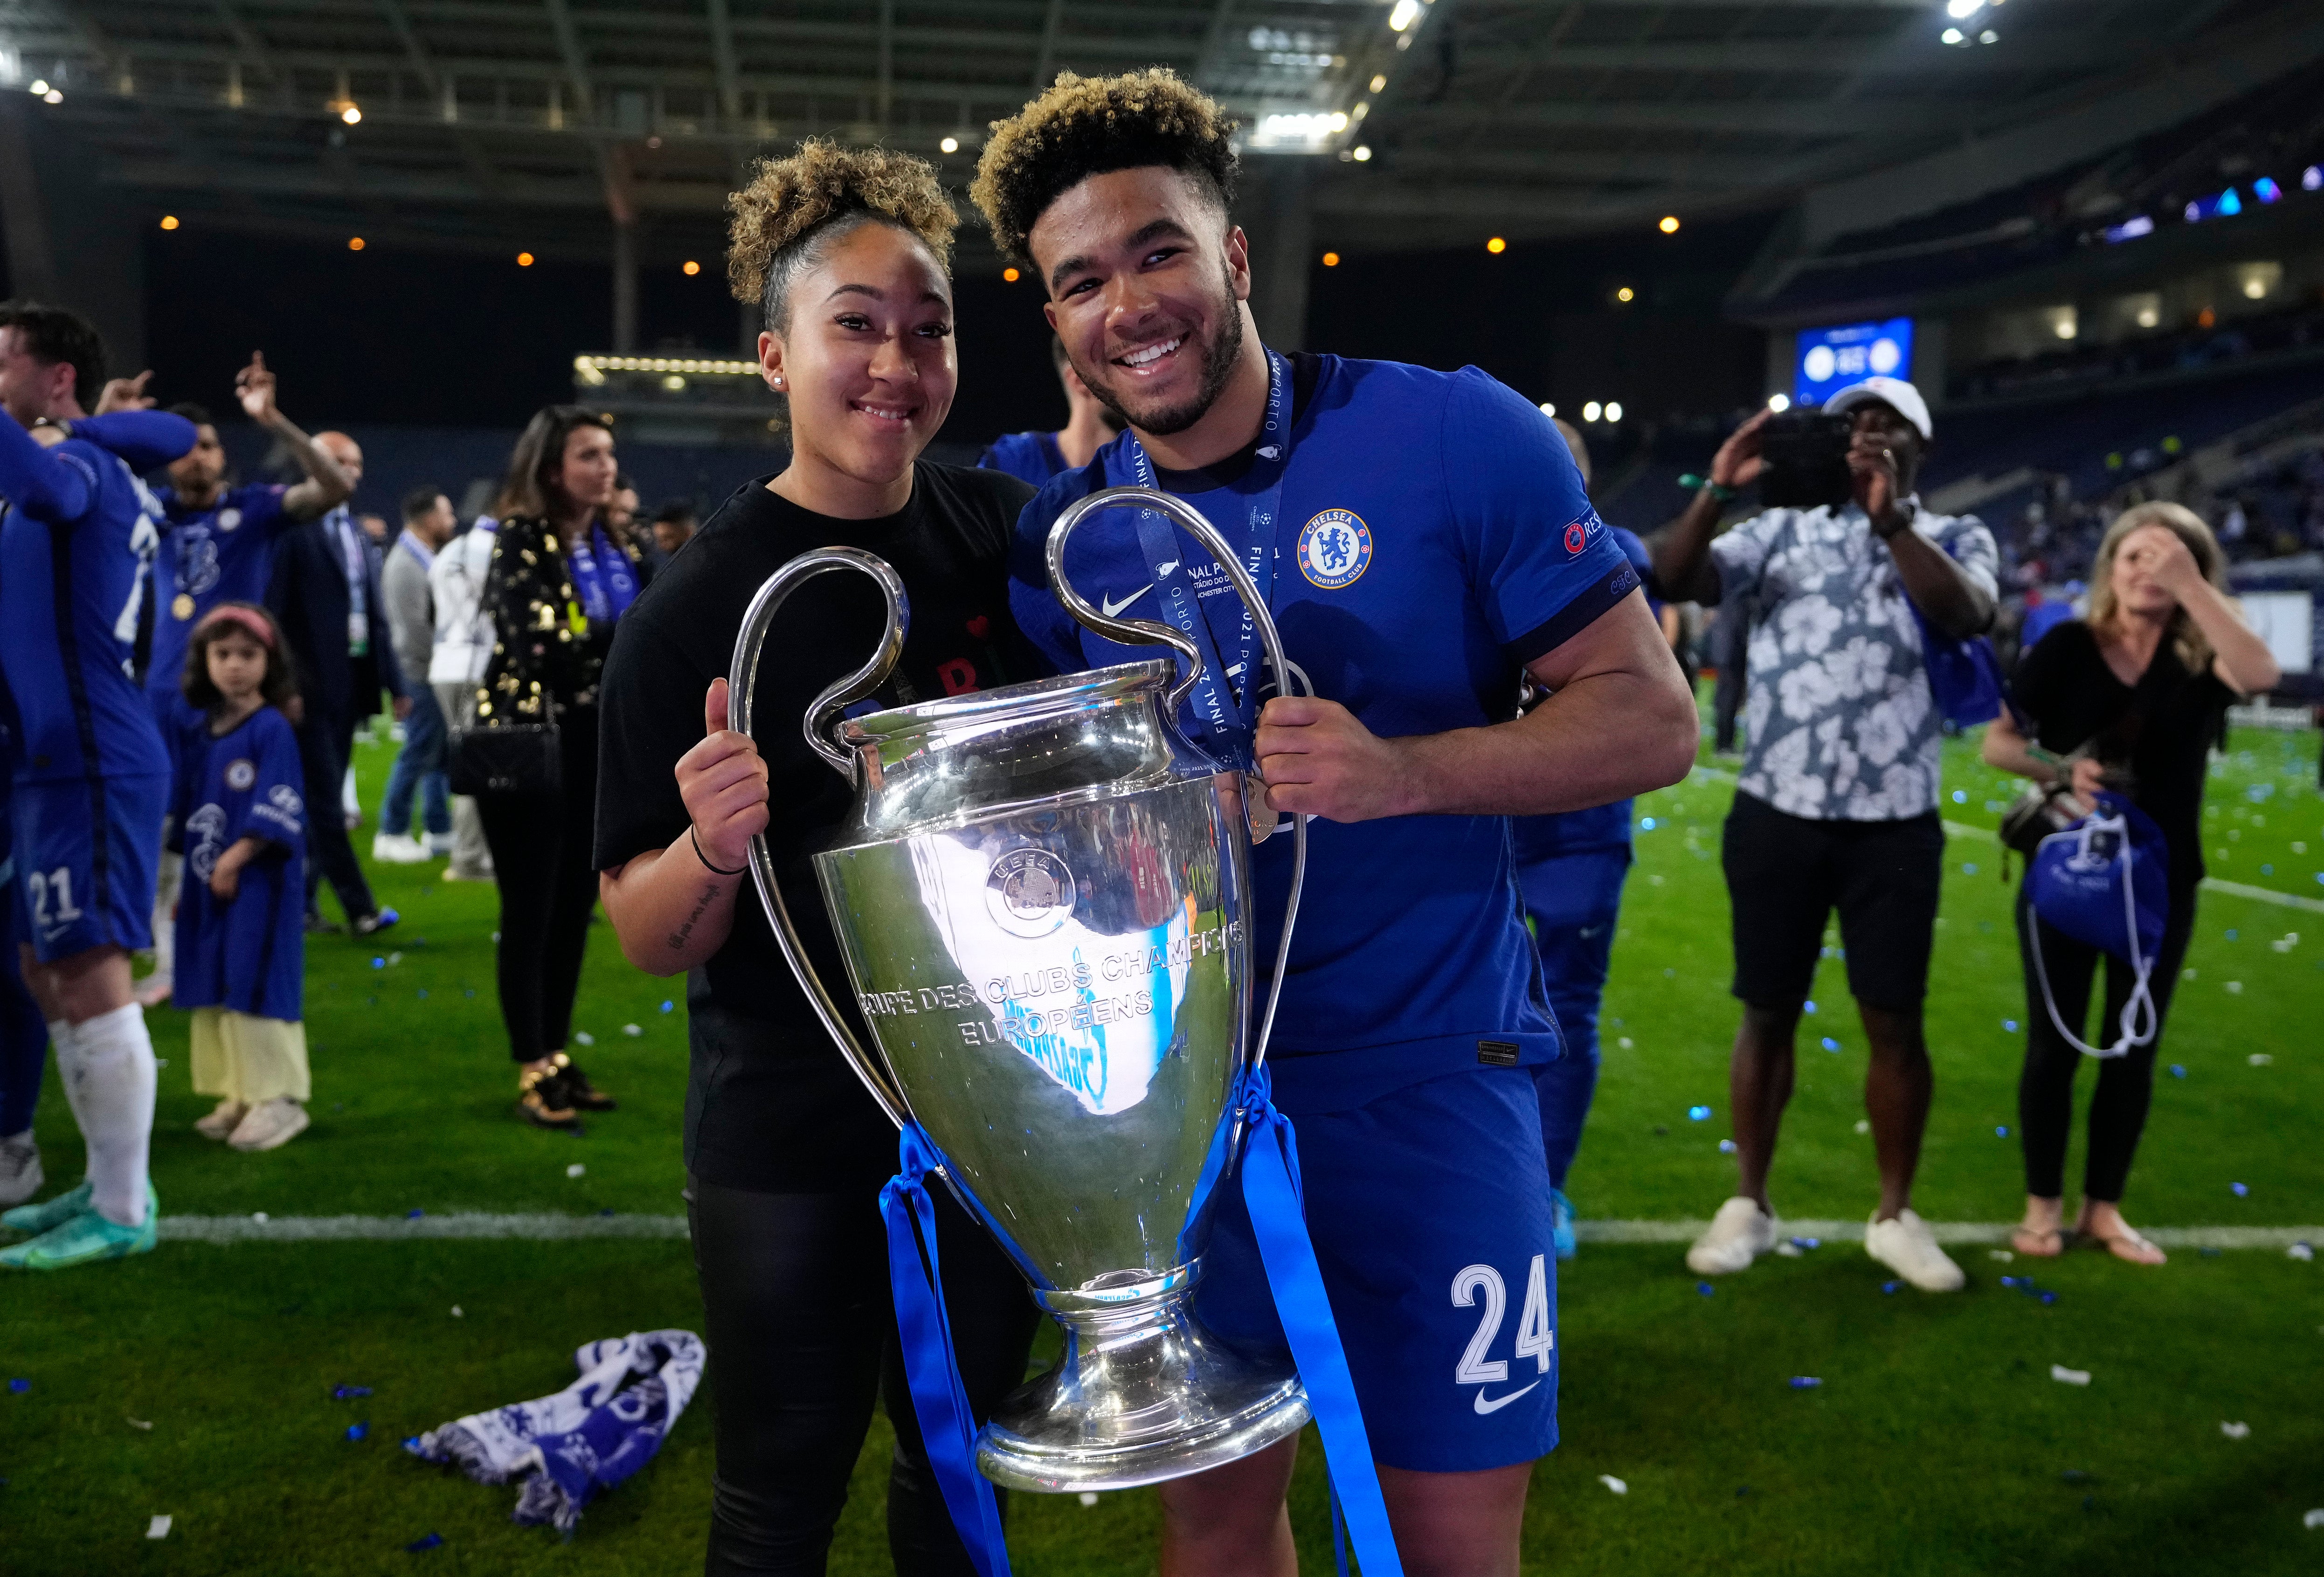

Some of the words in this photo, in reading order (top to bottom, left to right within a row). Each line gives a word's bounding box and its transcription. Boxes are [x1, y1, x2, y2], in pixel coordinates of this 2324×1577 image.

[1266, 378, 1282, 430] PORTO
[1134, 450, 1150, 488] FINAL
[1307, 512, 1352, 535] CHELSEA
[1567, 526, 1579, 535] UEFA
[1584, 510, 1603, 538] RES
[1187, 565, 1212, 579] NAL
[1214, 576, 1224, 585] DO
[1248, 546, 1262, 583] FINA
[1314, 574, 1347, 585] FOOTBALL
[1348, 563, 1363, 579] CLUB
[1241, 606, 1253, 641] 021
[1204, 688, 1227, 734] FINAL
[994, 853, 1050, 878] UEFA
[29, 866, 83, 926] 21
[858, 990, 918, 1017] COUPE
[917, 982, 978, 1012] DES
[984, 962, 1093, 1004] CLUBS
[1101, 920, 1243, 982] CHAMPIONS
[957, 989, 1154, 1048] EUROPÉENS
[1451, 1254, 1553, 1384] 24
